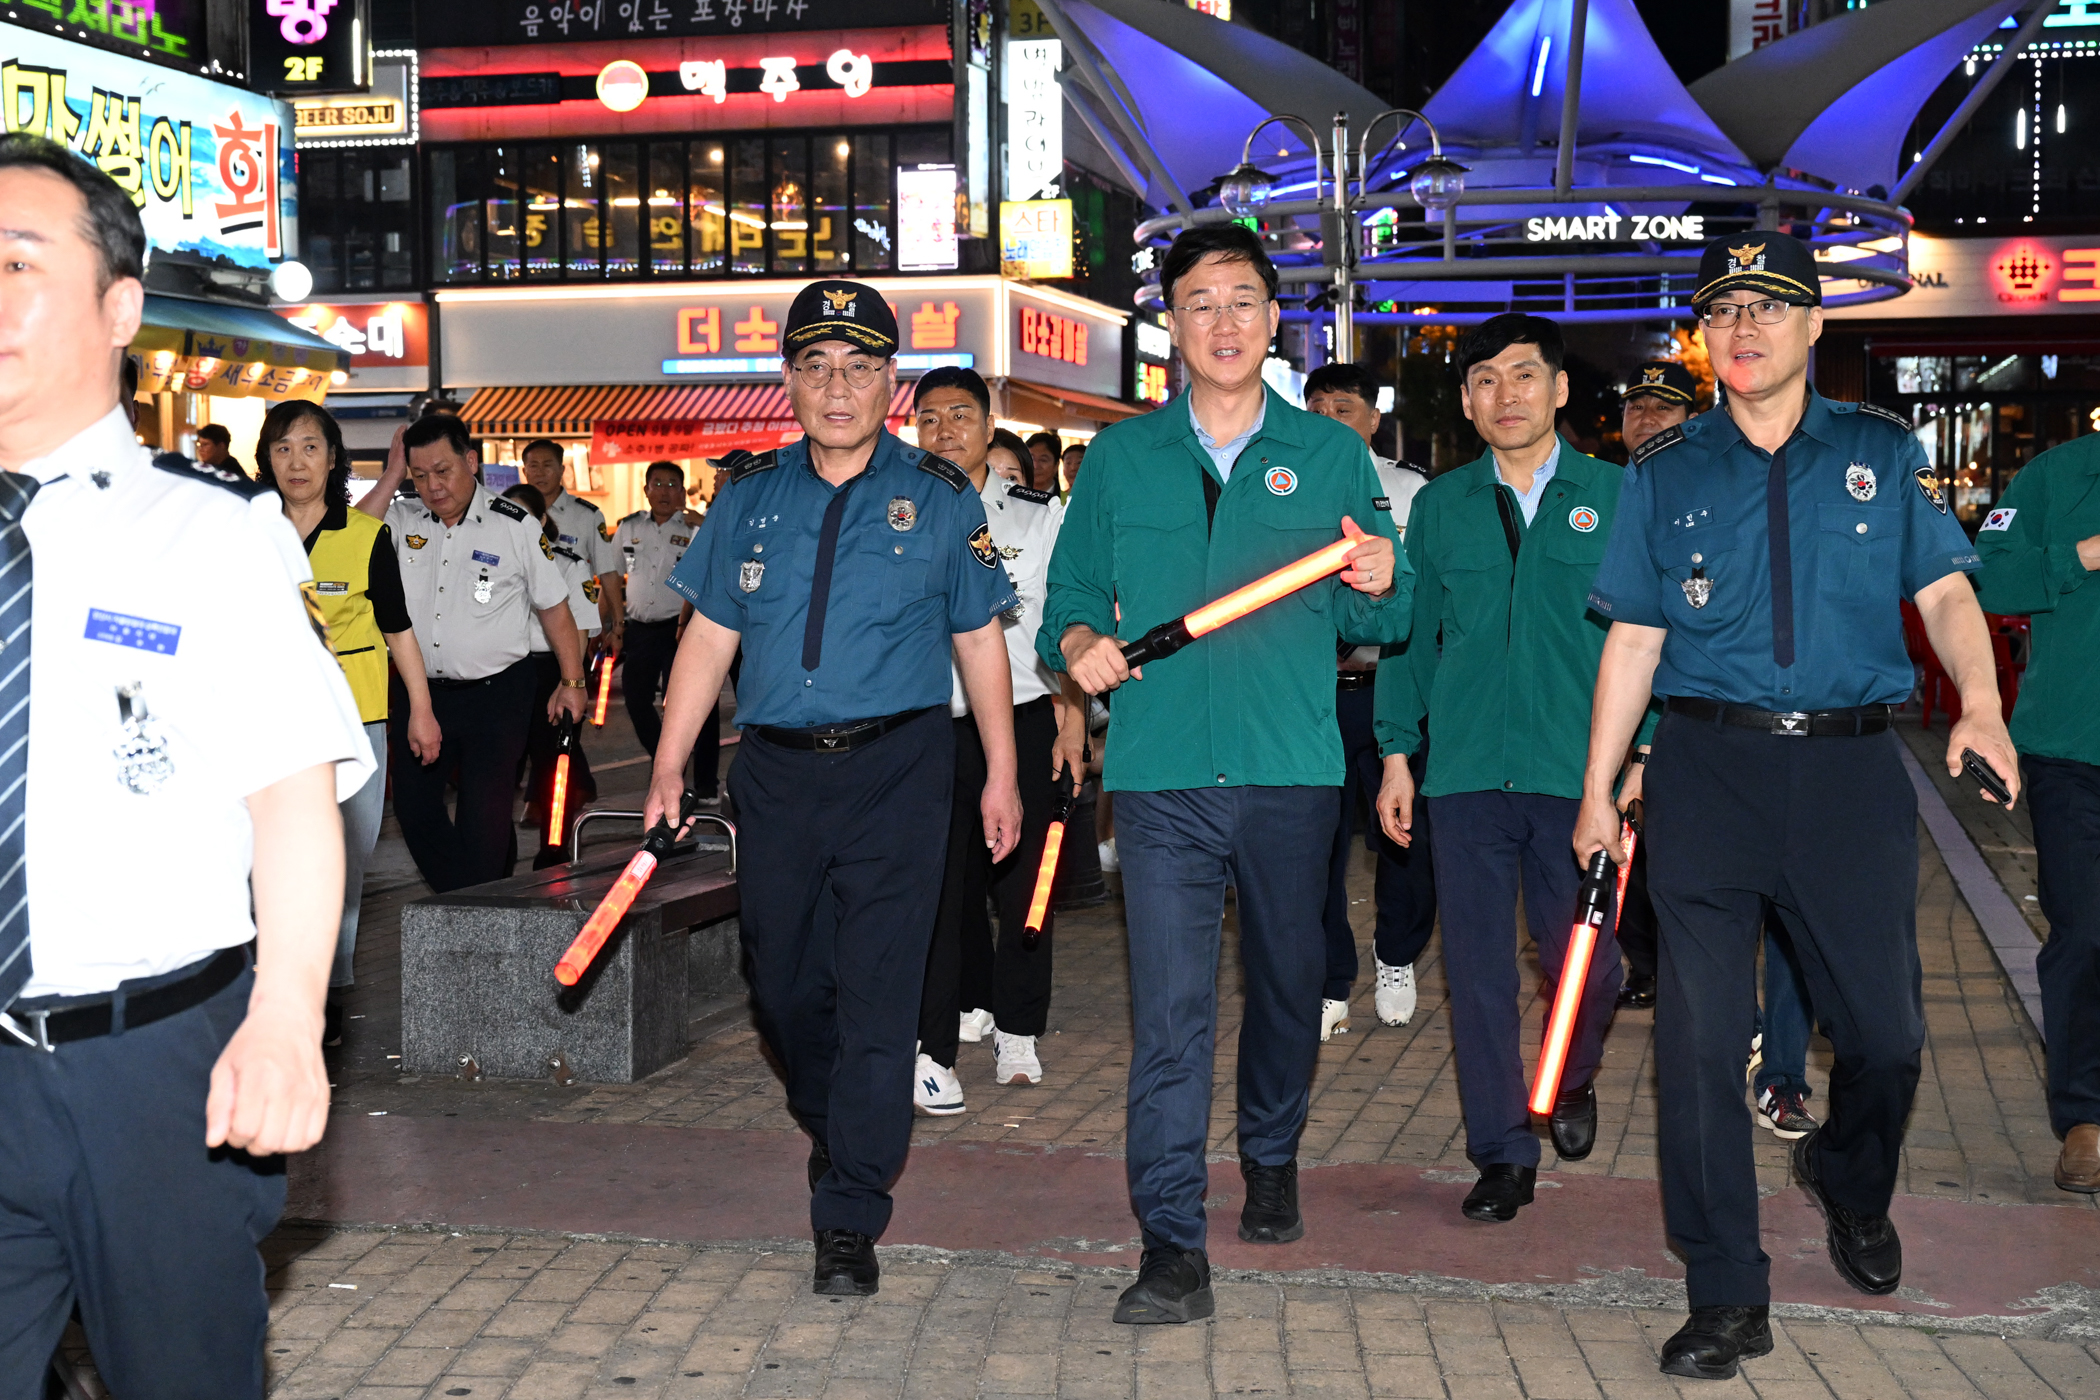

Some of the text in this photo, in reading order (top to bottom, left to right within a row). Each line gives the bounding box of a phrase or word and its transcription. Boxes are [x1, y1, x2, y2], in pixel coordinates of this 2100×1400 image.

[520, 0, 600, 37] 음악이
[619, 0, 672, 32] 있는
[284, 57, 323, 81] 2F
[295, 107, 392, 126] BEER SOJU
[1014, 210, 1059, 234] 스타
[1527, 216, 1704, 242] SMART ZONE
[605, 424, 647, 437] OPEN
[922, 1076, 941, 1097] N
